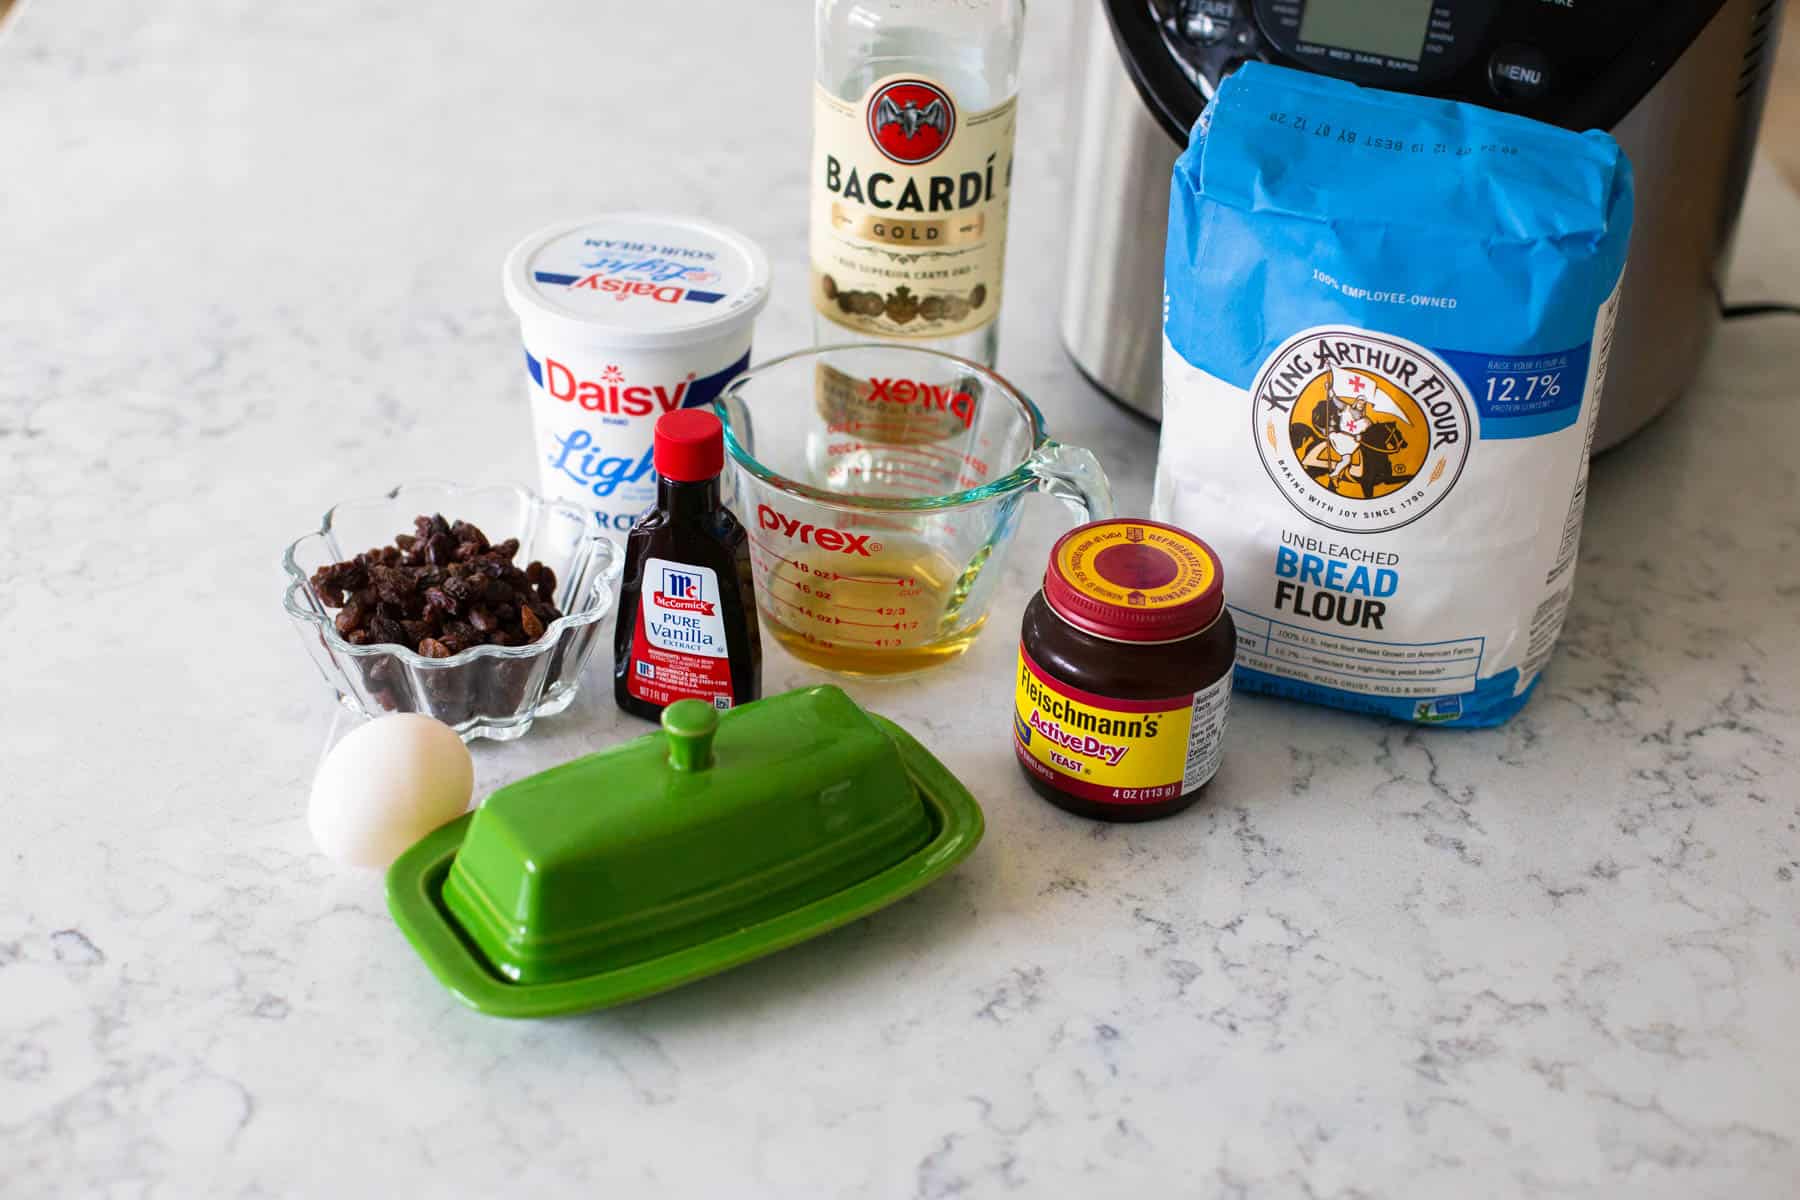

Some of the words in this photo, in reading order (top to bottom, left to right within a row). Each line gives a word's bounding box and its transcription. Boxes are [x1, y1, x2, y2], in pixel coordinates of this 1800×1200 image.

[1497, 63, 1542, 85] MENU
[1293, 115, 1307, 131] 12
[1337, 128, 1357, 144] BY
[1366, 136, 1404, 152] BEST
[827, 152, 997, 213] BACARDÍ
[873, 223, 939, 240] GOLD
[584, 238, 658, 254] CREAM
[662, 244, 716, 261] SOUR
[580, 256, 706, 282] Light
[575, 273, 685, 304] Daisy
[1312, 267, 1339, 290] 100%
[1342, 283, 1458, 310] EMPLOYEE-OWNED
[1262, 353, 1313, 414] KING
[1313, 338, 1419, 388] ARTHUR
[1411, 374, 1460, 451] FLOUR
[1486, 371, 1561, 402] 12.7%
[1277, 458, 1306, 496] BAKING
[1307, 494, 1335, 513] WITH
[1338, 510, 1358, 519] JOY
[1363, 507, 1396, 519] SINCE
[1400, 489, 1426, 509] 1790
[1281, 529, 1400, 567] UNBLEACHED
[1275, 545, 1400, 599] BREAD
[655, 594, 707, 611] McCormick
[1274, 580, 1387, 630] FLOUR
[663, 613, 701, 629] PURE
[650, 622, 713, 645] Vanilla
[663, 638, 702, 651] EXTRACT
[1021, 664, 1159, 739] Fleischmann's
[1050, 750, 1083, 773] YEAST
[1112, 790, 1119, 799] 4
[1124, 790, 1137, 799] OZ
[1140, 787, 1162, 800] (113
